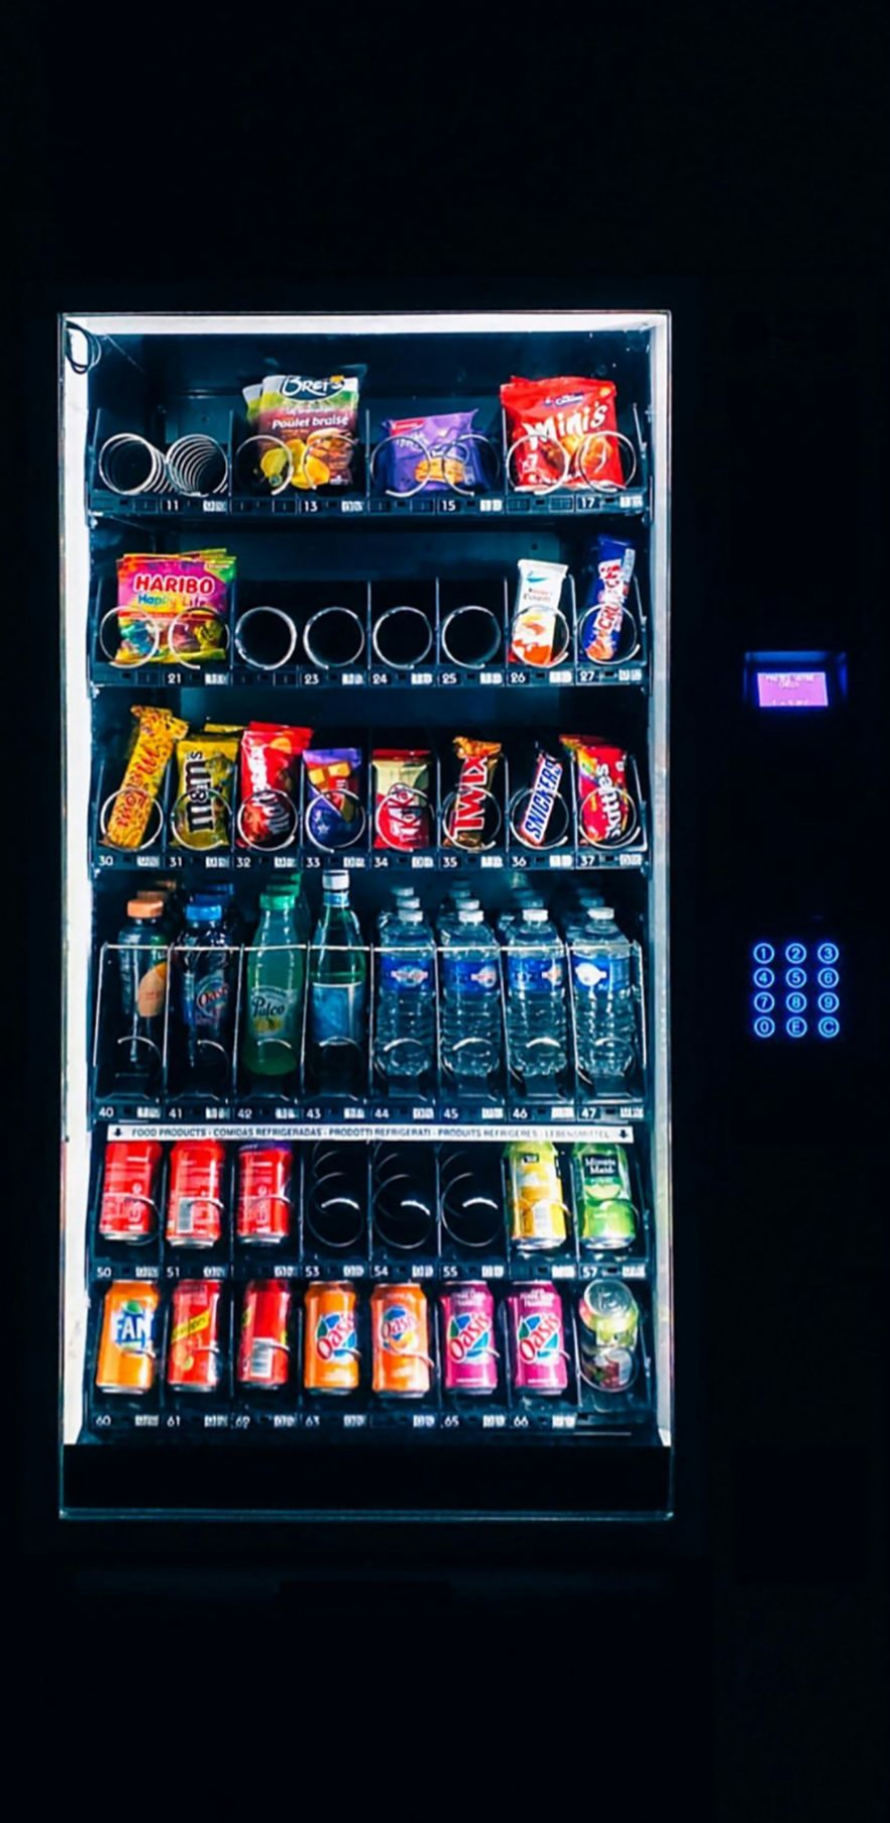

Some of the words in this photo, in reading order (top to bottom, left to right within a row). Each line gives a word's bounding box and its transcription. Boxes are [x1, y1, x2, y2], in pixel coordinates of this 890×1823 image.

[272, 418, 310, 430] Poulet
[167, 499, 179, 511] 11
[304, 500, 318, 512] 13
[442, 499, 456, 512] 15
[578, 498, 595, 511] 17
[134, 573, 214, 595] HARIBO
[167, 672, 181, 684] 21
[304, 673, 319, 685] 23
[372, 673, 388, 685] 24
[442, 673, 457, 685] 25
[510, 672, 526, 684] 26
[580, 670, 595, 682] 27
[450, 757, 487, 838] TWIX
[524, 757, 562, 840] SNICKERS
[97, 855, 114, 869] 30
[170, 856, 182, 868] 31
[237, 856, 251, 868] 32
[306, 857, 321, 868] 33
[374, 856, 389, 868] 34
[443, 856, 458, 868] 35
[512, 856, 527, 867] 36
[581, 855, 595, 869] 37
[761, 947, 767, 960] 1
[790, 947, 801, 960] 2
[823, 947, 834, 960] 3
[758, 971, 768, 984] 4
[791, 971, 801, 984] 5
[823, 972, 833, 984] 6
[251, 995, 286, 1018] Pulco
[760, 996, 769, 1009] 7
[791, 996, 801, 1009] 8
[823, 996, 834, 1009] 9
[759, 1020, 770, 1033] 0
[791, 1020, 801, 1034] E
[822, 1020, 835, 1033] C
[98, 1106, 114, 1118] 40
[169, 1108, 182, 1119] 41
[237, 1108, 253, 1119] 42
[306, 1108, 322, 1119] 43
[374, 1108, 390, 1119] 44
[443, 1108, 459, 1119] 45
[512, 1108, 528, 1119] 46
[581, 1107, 597, 1119] 47
[132, 1127, 157, 1137] FOOD
[159, 1127, 206, 1137] PRODUCTS
[213, 1127, 253, 1137] COMIDAS
[255, 1127, 322, 1137] REFRIGERADAS
[329, 1128, 372, 1137] PRODOTTI
[374, 1128, 431, 1137] REFRIGERATI
[438, 1128, 481, 1138] PRODUITS
[96, 1266, 112, 1278] 50
[166, 1266, 180, 1278] 51
[305, 1265, 320, 1277] 53
[374, 1265, 389, 1277] 54
[443, 1265, 458, 1278] 55
[582, 1265, 598, 1279] 57
[449, 1311, 492, 1362] Oasis
[518, 1311, 561, 1362] Oasis
[95, 1414, 112, 1425] 60
[166, 1415, 181, 1427] 61
[305, 1415, 320, 1425] 63
[444, 1415, 460, 1427] 65
[513, 1415, 529, 1427] 66
